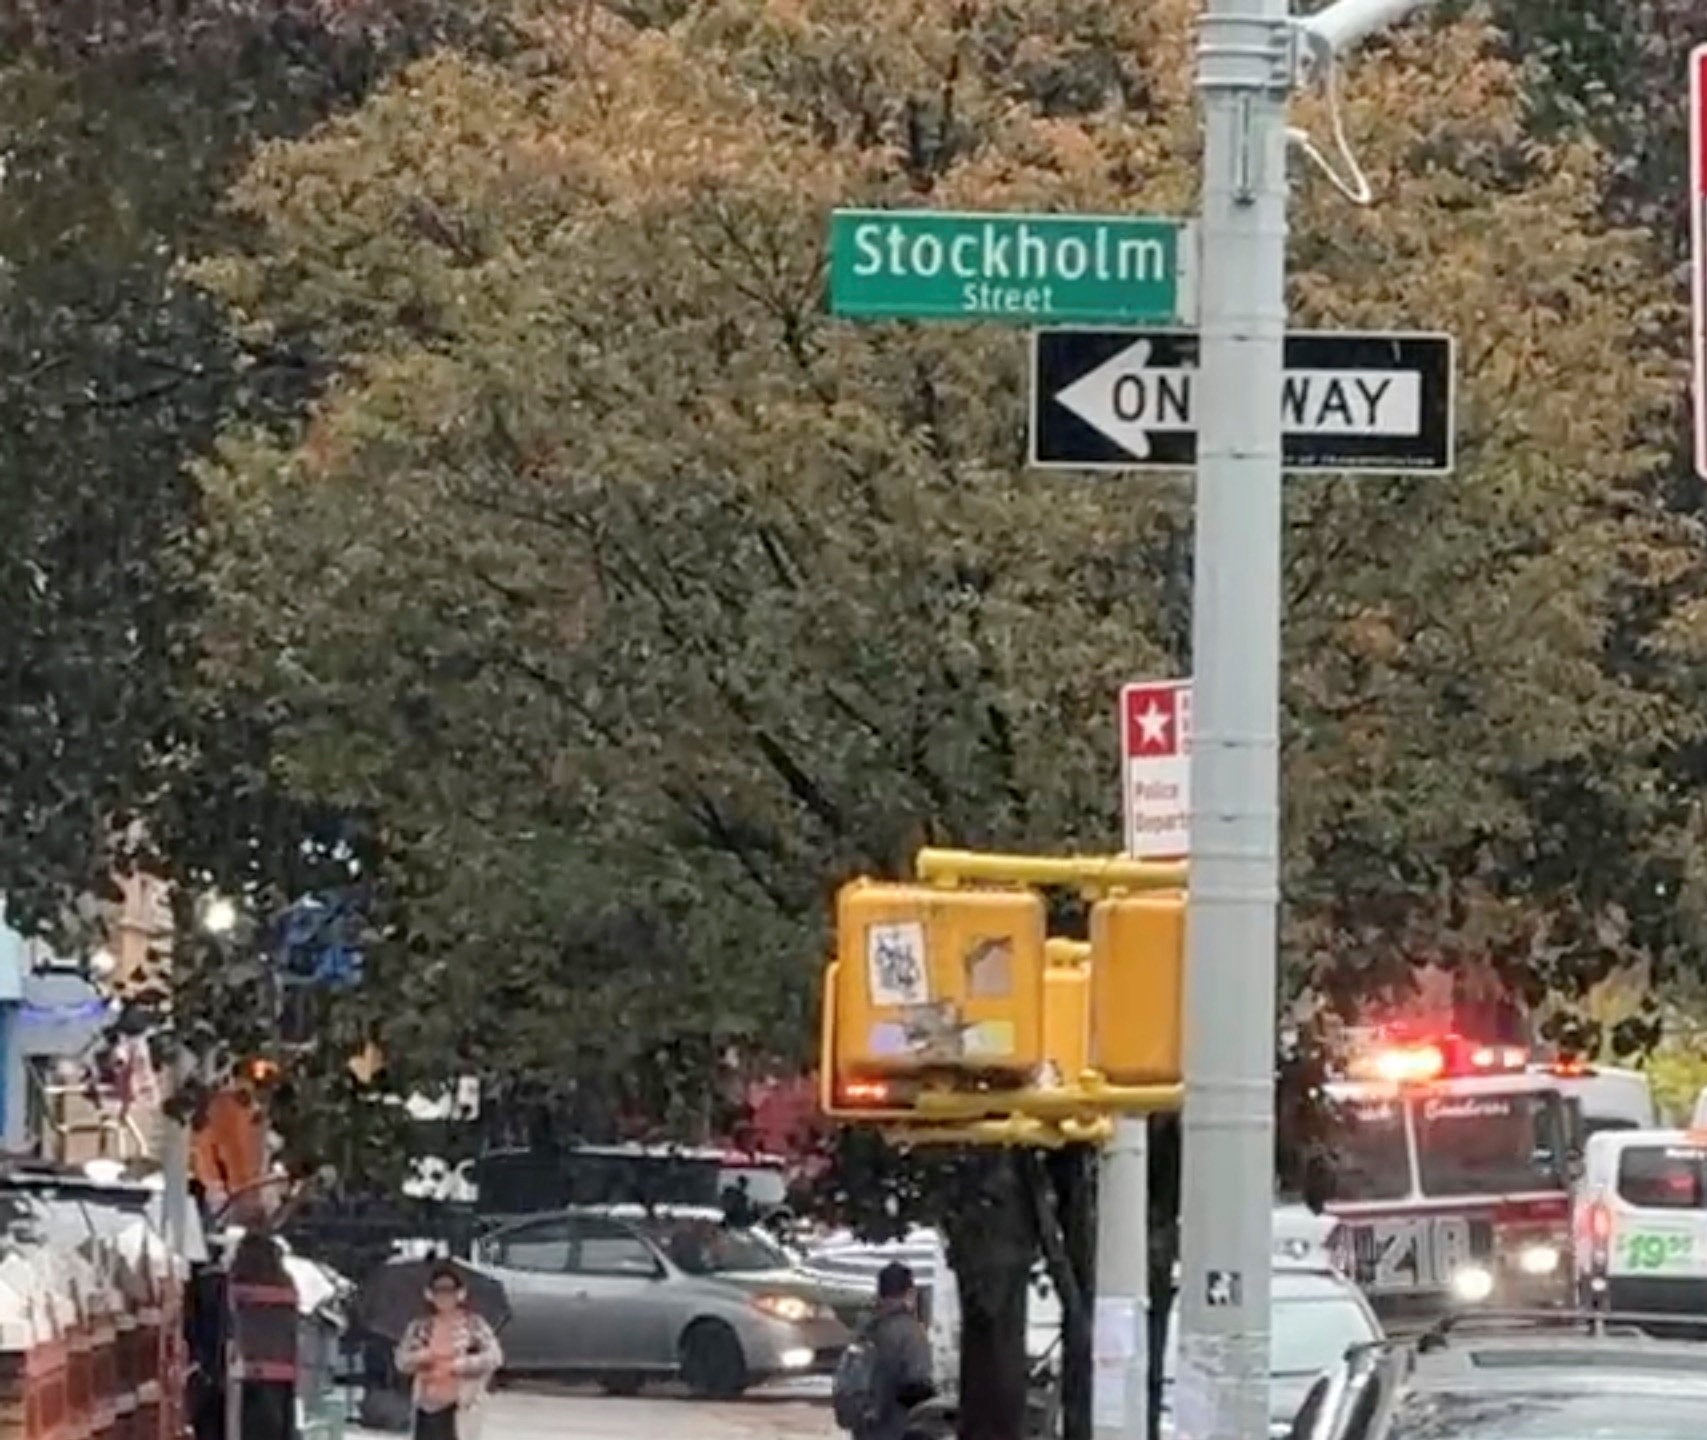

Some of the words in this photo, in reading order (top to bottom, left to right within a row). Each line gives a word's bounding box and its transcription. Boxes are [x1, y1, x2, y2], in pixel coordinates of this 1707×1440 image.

[853, 223, 1165, 281] Stockholm
[962, 284, 1054, 312] Street
[1112, 373, 1192, 423] ON
[1282, 377, 1391, 426] WAY
